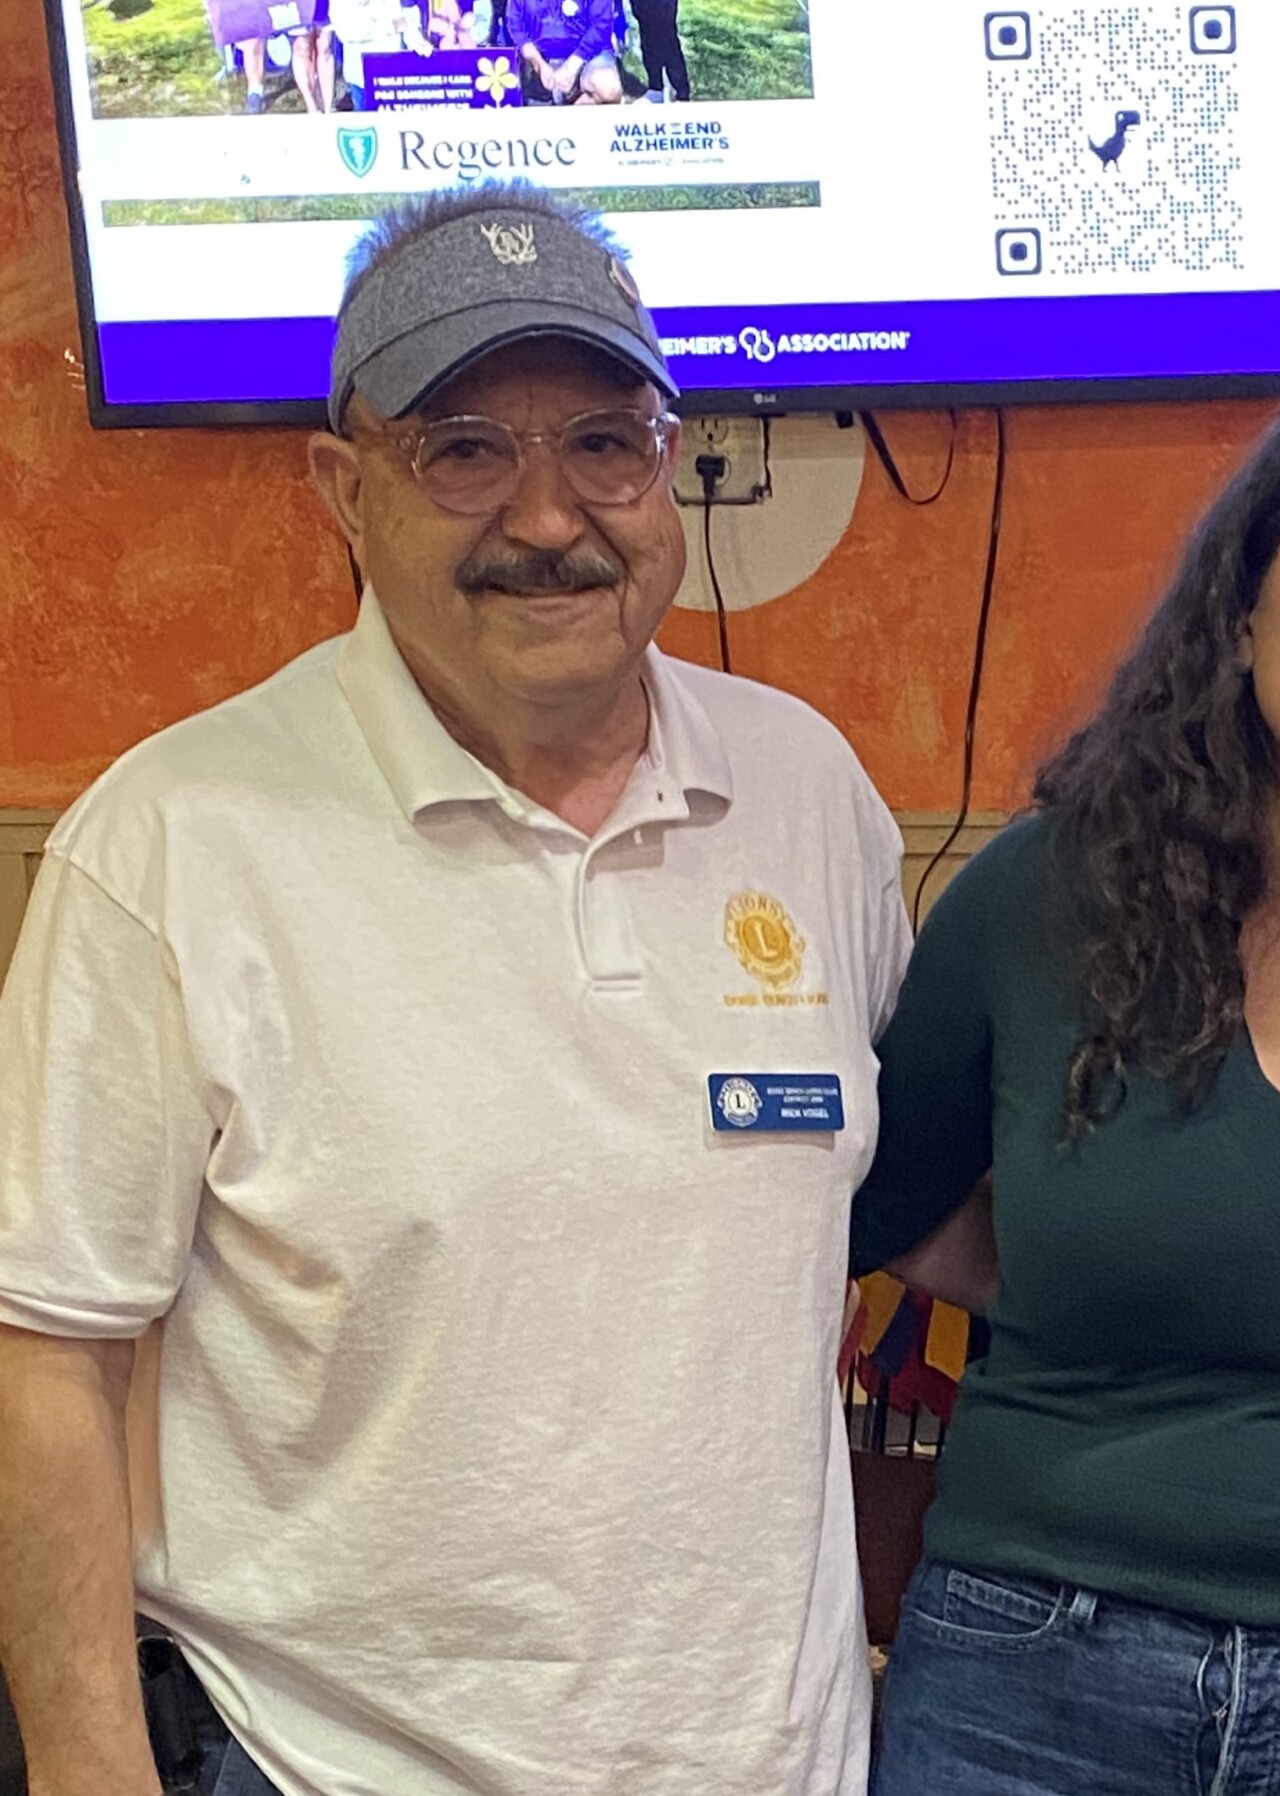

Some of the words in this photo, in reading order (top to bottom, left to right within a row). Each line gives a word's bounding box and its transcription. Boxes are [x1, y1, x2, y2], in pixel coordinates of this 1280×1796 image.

[614, 123, 667, 137] WALK
[610, 137, 730, 152] ALZHEIMER'S
[398, 130, 576, 181] Regence
[658, 335, 737, 357] EIMER'S
[777, 331, 908, 354] ASSOCIATION
